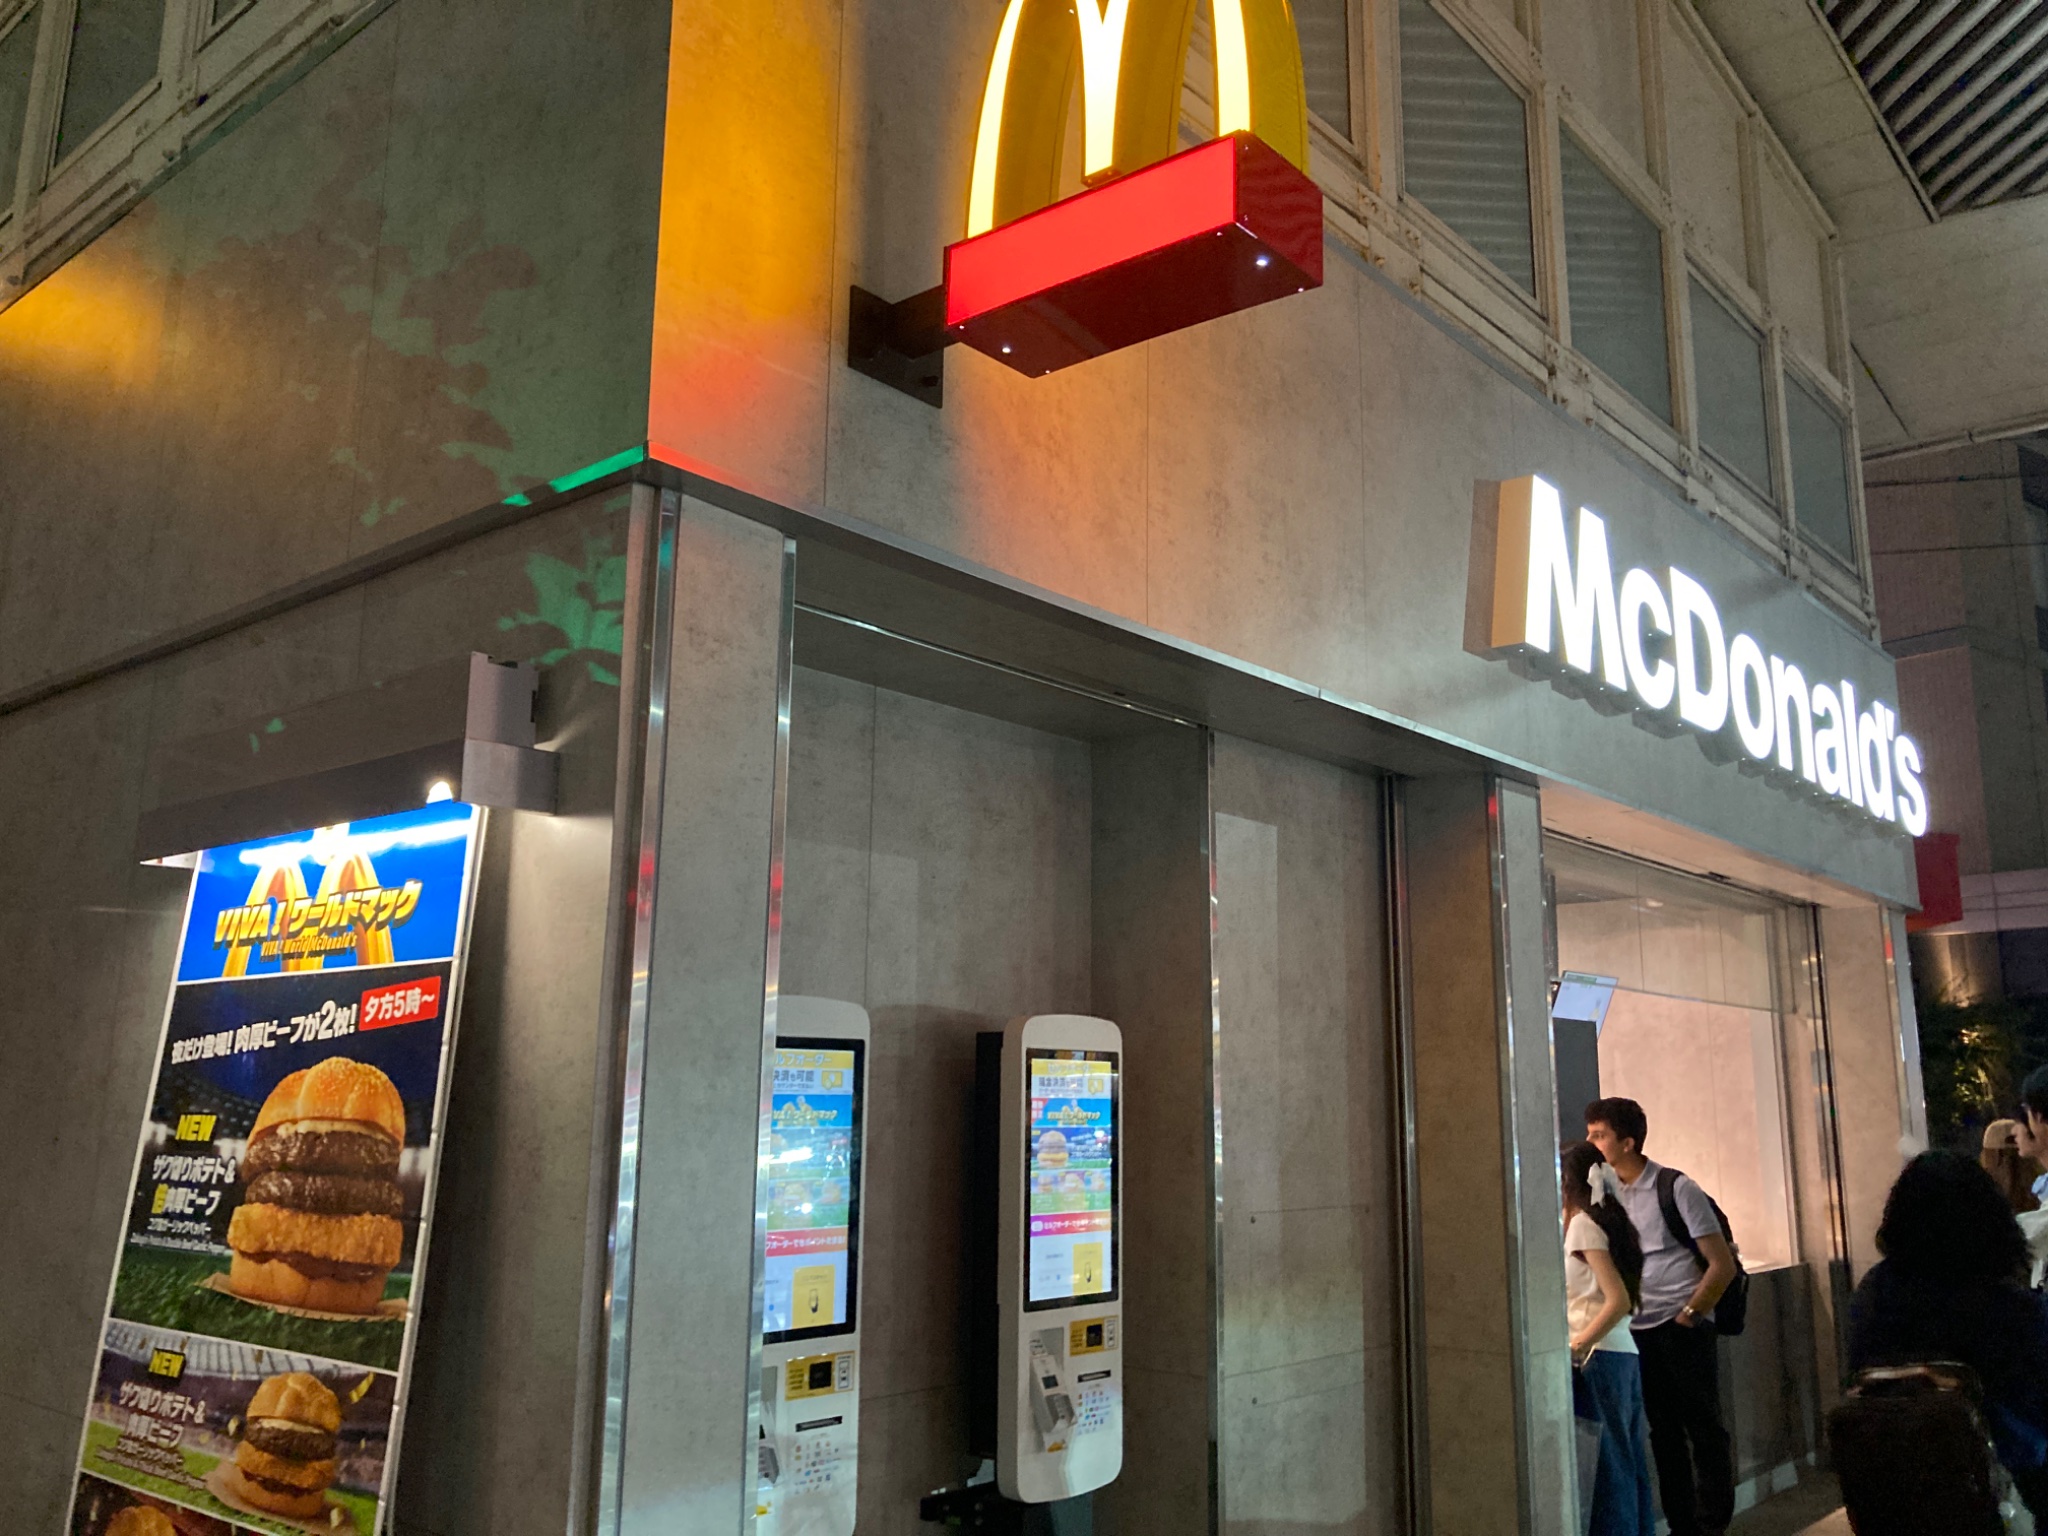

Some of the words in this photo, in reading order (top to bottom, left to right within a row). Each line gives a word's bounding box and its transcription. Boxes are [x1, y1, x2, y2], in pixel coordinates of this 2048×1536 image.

[1525, 474, 1928, 836] McDonald's
[175, 1114, 217, 1141] NEW
[148, 1349, 184, 1378] NEW
